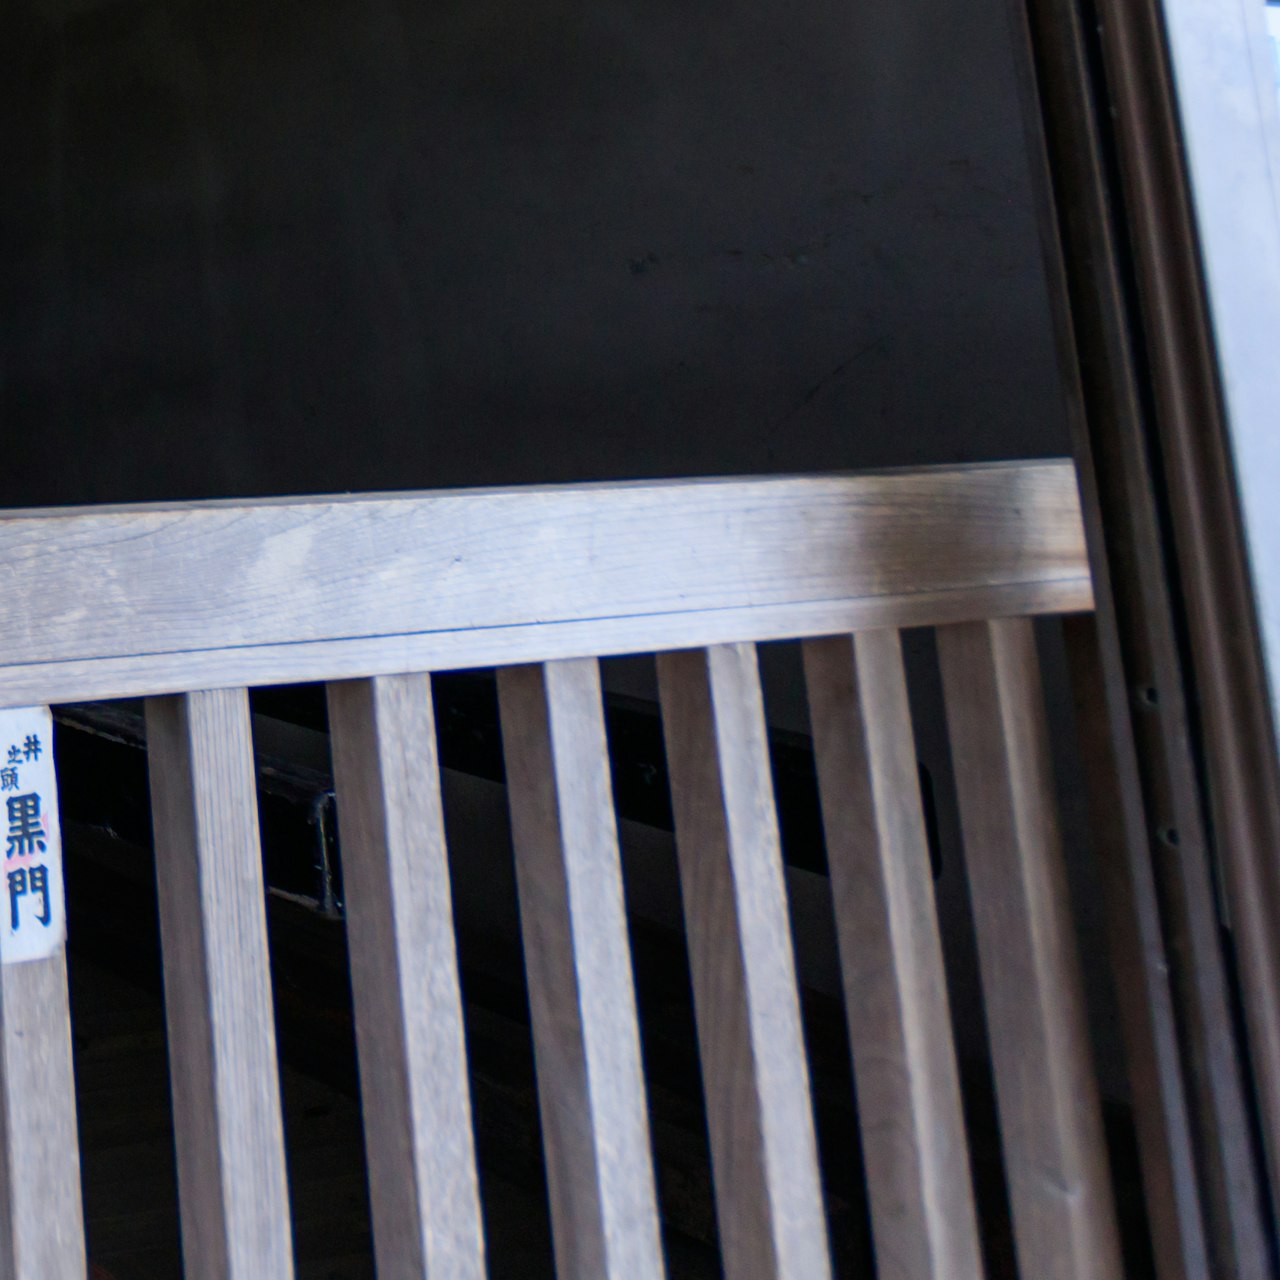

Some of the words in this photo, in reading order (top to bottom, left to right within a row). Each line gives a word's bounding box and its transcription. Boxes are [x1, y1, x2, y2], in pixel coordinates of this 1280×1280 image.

[0, 734, 42, 791] 井之頭
[6, 792, 51, 930] 黒門
